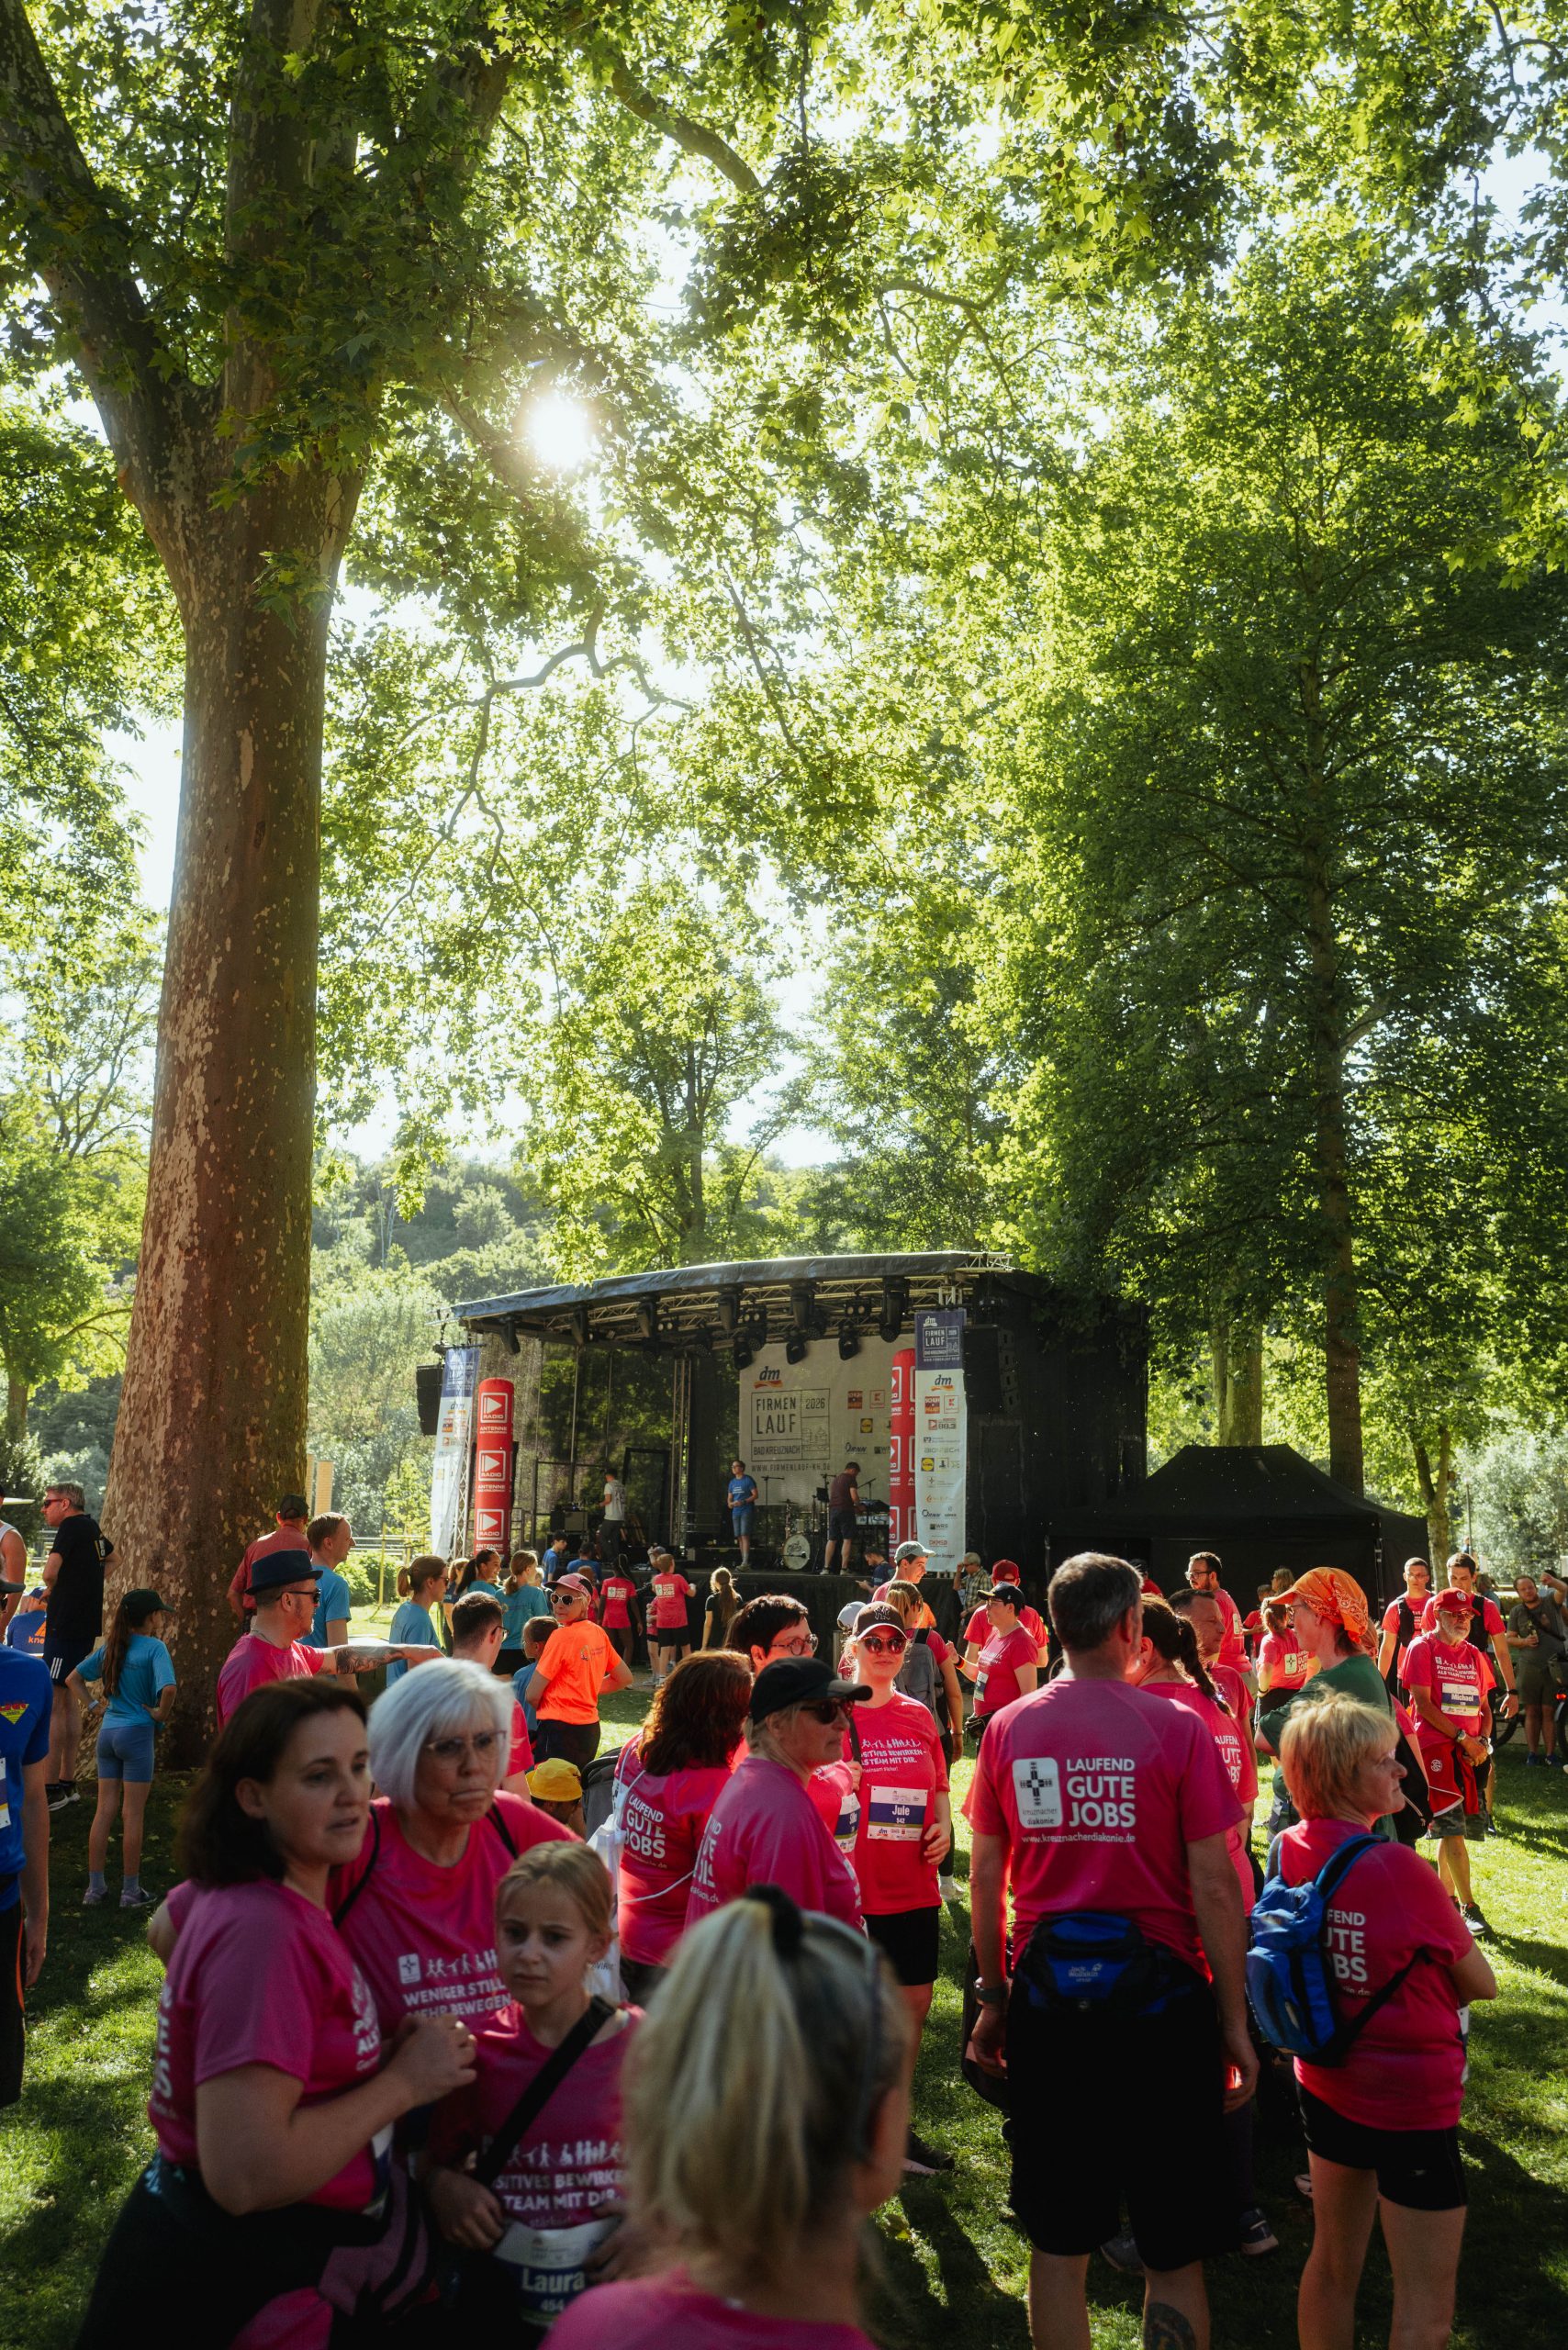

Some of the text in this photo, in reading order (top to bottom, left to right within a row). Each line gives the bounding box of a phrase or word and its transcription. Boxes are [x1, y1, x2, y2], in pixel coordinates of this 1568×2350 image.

[925, 1337, 946, 1346] LAUF
[759, 1366, 780, 1381] dm
[935, 1374, 952, 1385] dm
[756, 1396, 797, 1412] FIRMEN
[756, 1414, 797, 1435] LAUF
[754, 1445, 801, 1456] BAD KREUZNACH
[1451, 1693, 1474, 1702] Michael
[1215, 1735, 1239, 1746] AUFEN
[861, 1750, 888, 1758] SITIVES
[1222, 1748, 1241, 1764] UTE
[1067, 1757, 1136, 1772] LAUFEND
[1067, 1775, 1136, 1799] GUTE
[628, 1794, 664, 1823] LAUFEND
[892, 1805, 911, 1816] Jule
[1069, 1801, 1137, 1828] JOBS
[1021, 1832, 1136, 1843] www.kreuznacherdiakonie.de
[1327, 1908, 1366, 1926] FEND
[1324, 1927, 1366, 1954] UTE
[1332, 1953, 1368, 1983] BS
[402, 1984, 466, 2007] WENIGER
[406, 1993, 512, 2019] EHR BEWEGEN
[496, 2169, 625, 2189] SITIVES BEWIRKE
[504, 2194, 549, 2210] TEAM
[553, 2192, 583, 2209] MIT
[521, 2267, 586, 2293] Laura
